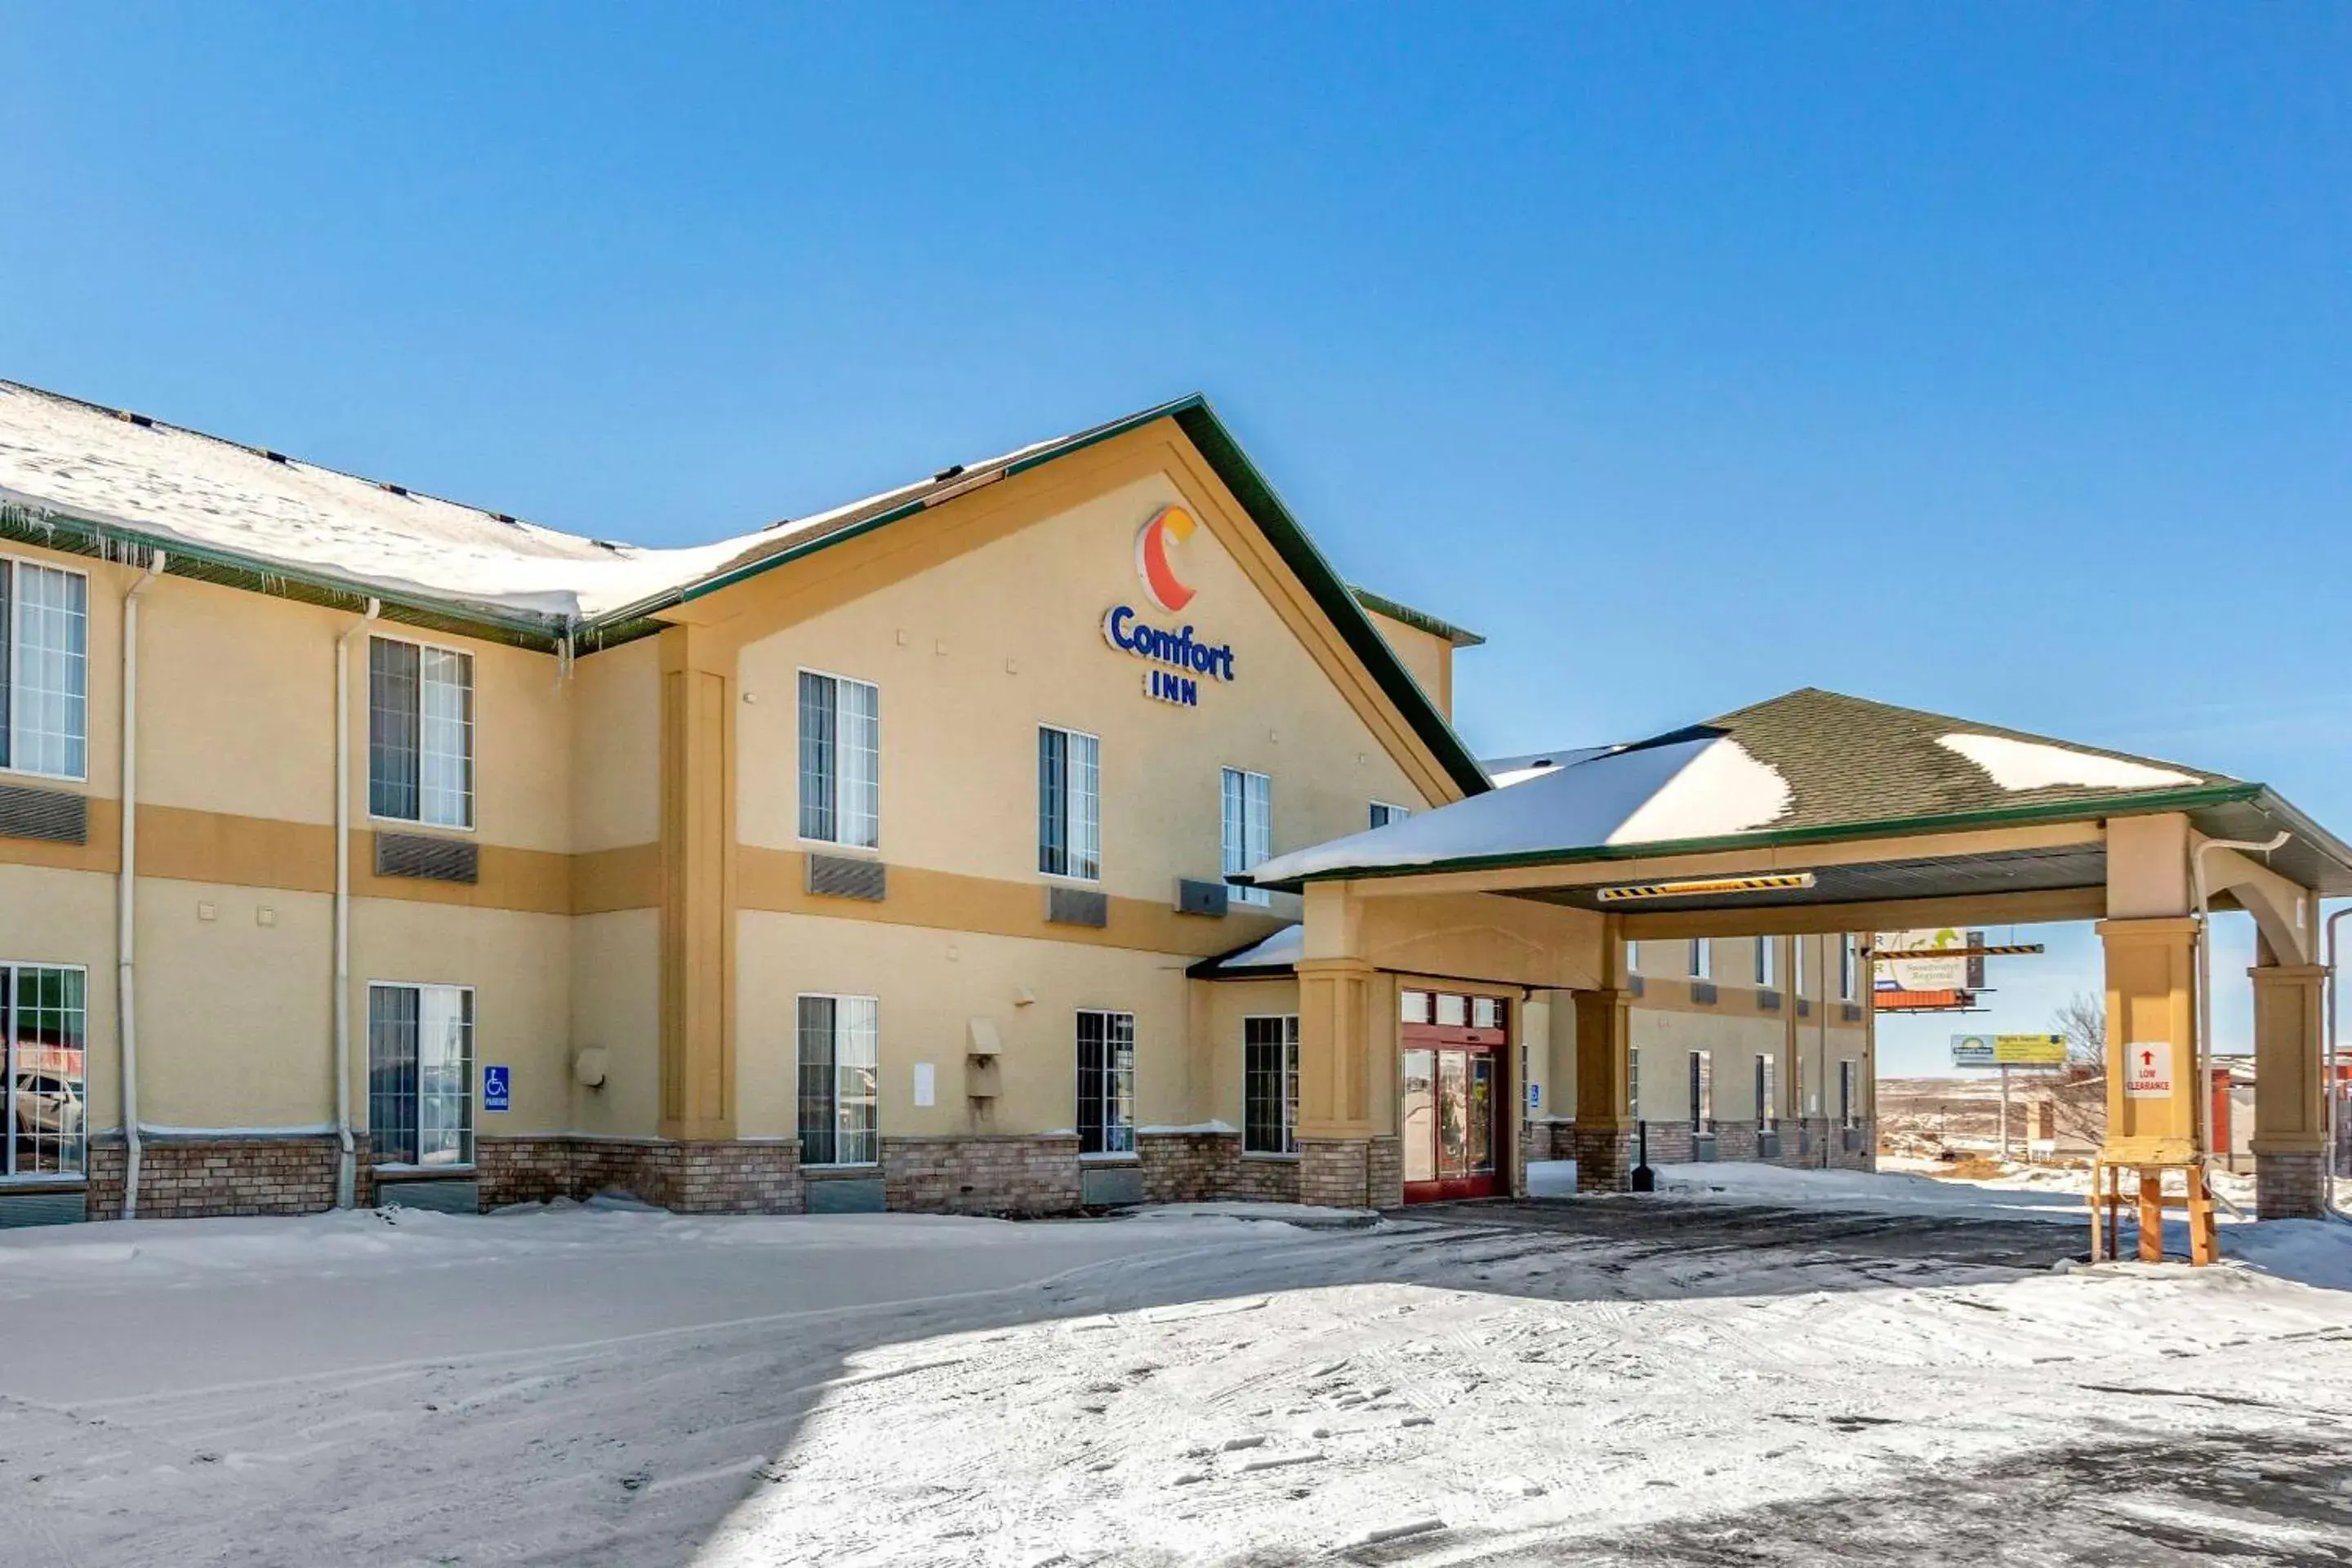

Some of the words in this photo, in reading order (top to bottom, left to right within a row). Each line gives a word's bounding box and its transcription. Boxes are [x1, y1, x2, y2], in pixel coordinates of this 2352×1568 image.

[1106, 605, 1234, 681] Comfort
[1150, 670, 1197, 706] INN
[2126, 1080, 2170, 1090] CLEARANCE
[2139, 1070, 2156, 1078] LOW
